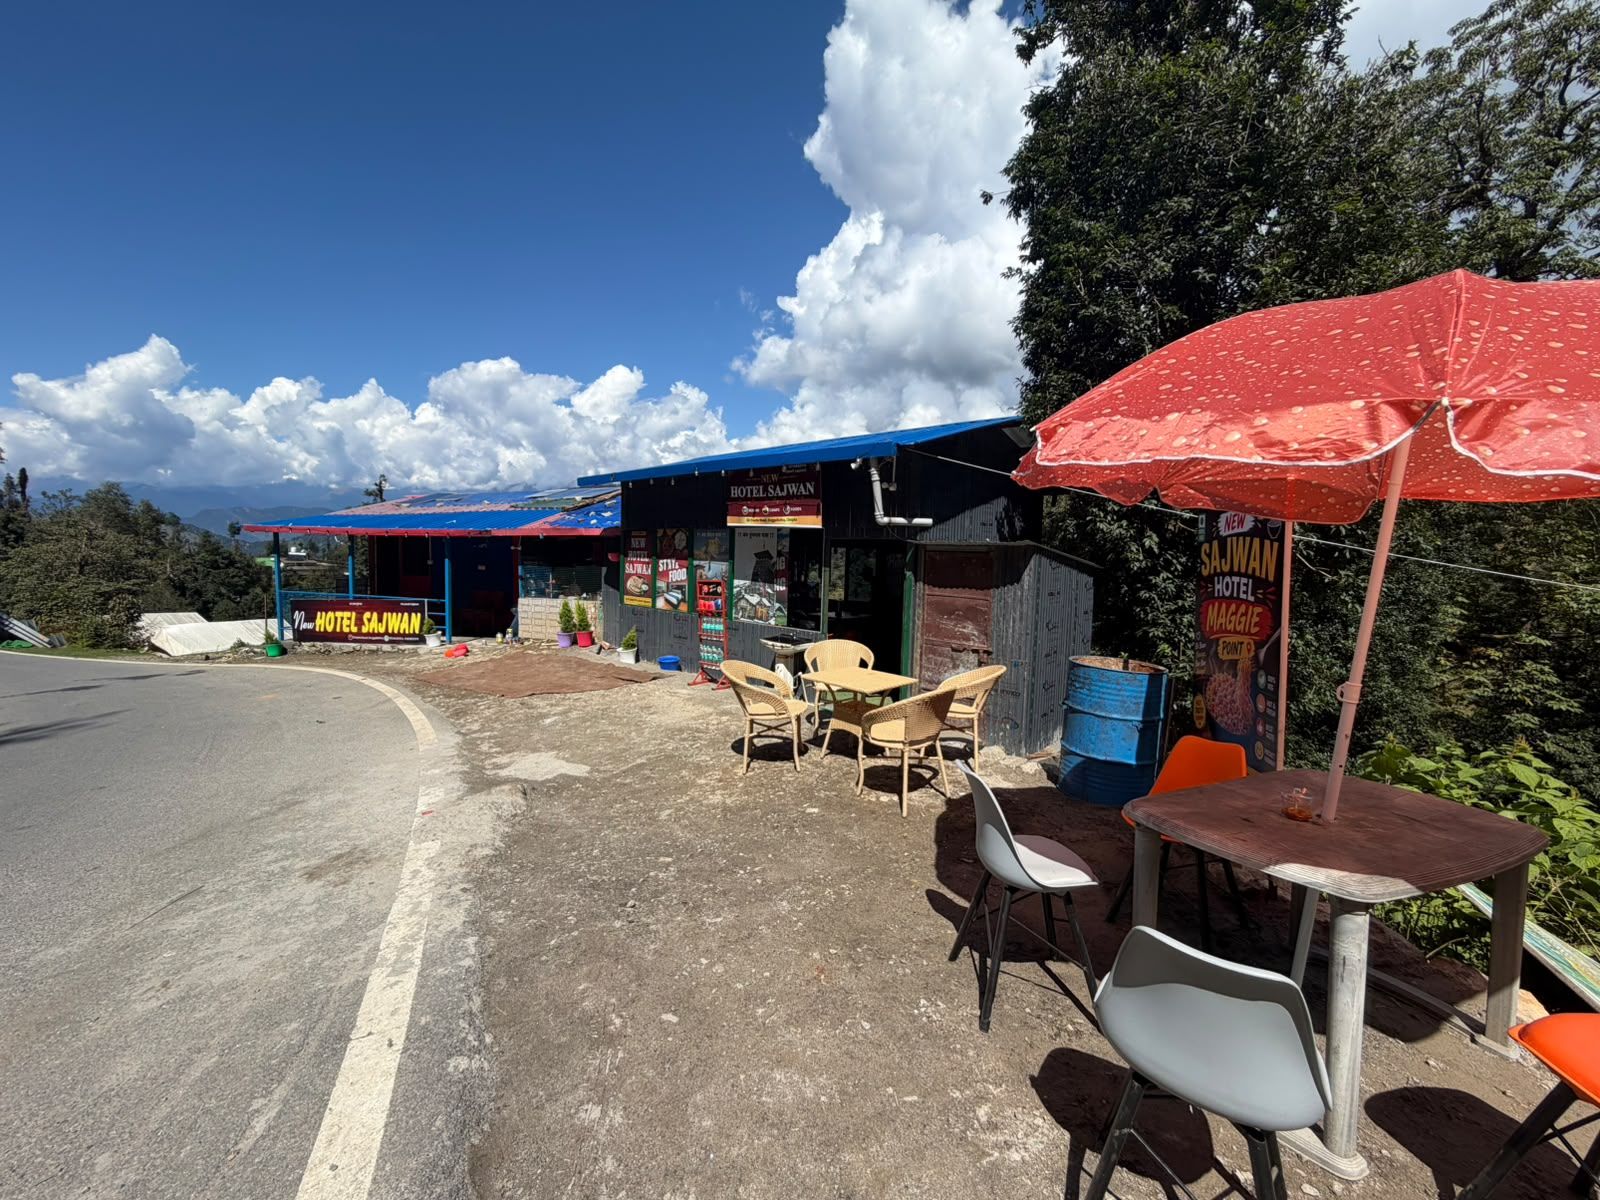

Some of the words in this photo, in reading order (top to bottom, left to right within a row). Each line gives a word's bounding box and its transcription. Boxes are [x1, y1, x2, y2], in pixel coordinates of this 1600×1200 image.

[761, 474, 780, 483] NEW
[730, 485, 767, 498] HOTEL
[767, 481, 816, 497] SAJWAN
[1223, 512, 1246, 533] NEW
[631, 537, 647, 548] NEW
[627, 550, 649, 562] HOTEL
[1200, 535, 1280, 583] SAJWAN
[625, 562, 652, 575] SAJWAN
[658, 558, 676, 572] STAY
[668, 567, 687, 583] FOOD
[1214, 575, 1255, 602] HOTEL
[293, 610, 314, 631] New
[315, 611, 358, 633] HOTEL
[361, 611, 422, 634] SAJWAN
[1206, 601, 1264, 634] MAGGIE
[1222, 640, 1244, 656] POINT
